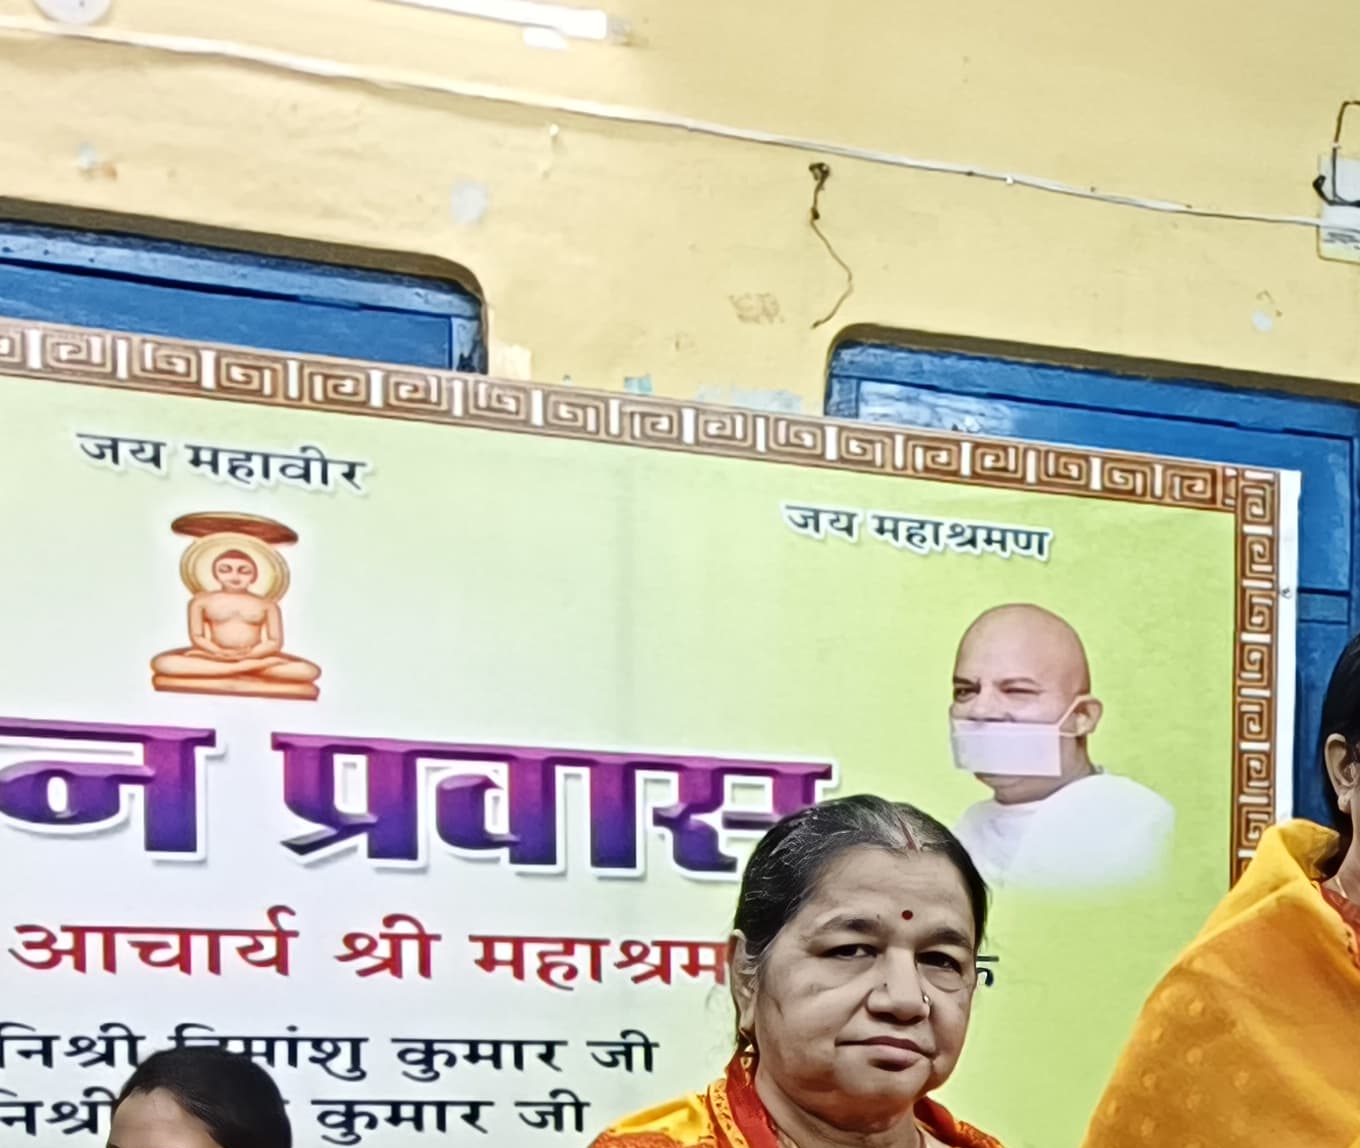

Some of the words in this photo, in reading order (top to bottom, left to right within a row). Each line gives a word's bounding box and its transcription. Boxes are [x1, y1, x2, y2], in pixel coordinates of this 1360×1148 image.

[77, 433, 165, 470] जय
[184, 443, 367, 489] महावीर
[785, 504, 858, 537] जय
[872, 513, 1050, 557] महाश्रमण
[0, 716, 216, 853] न
[9, 904, 299, 977] आचार्य
[334, 913, 442, 979] श्री
[468, 935, 732, 991] महाश्रम
[0, 1021, 147, 1068] निश्री
[390, 1037, 569, 1082] कुमार
[586, 1029, 661, 1073] जी
[310, 1099, 495, 1146] कुमार
[513, 1088, 592, 1133] जी
